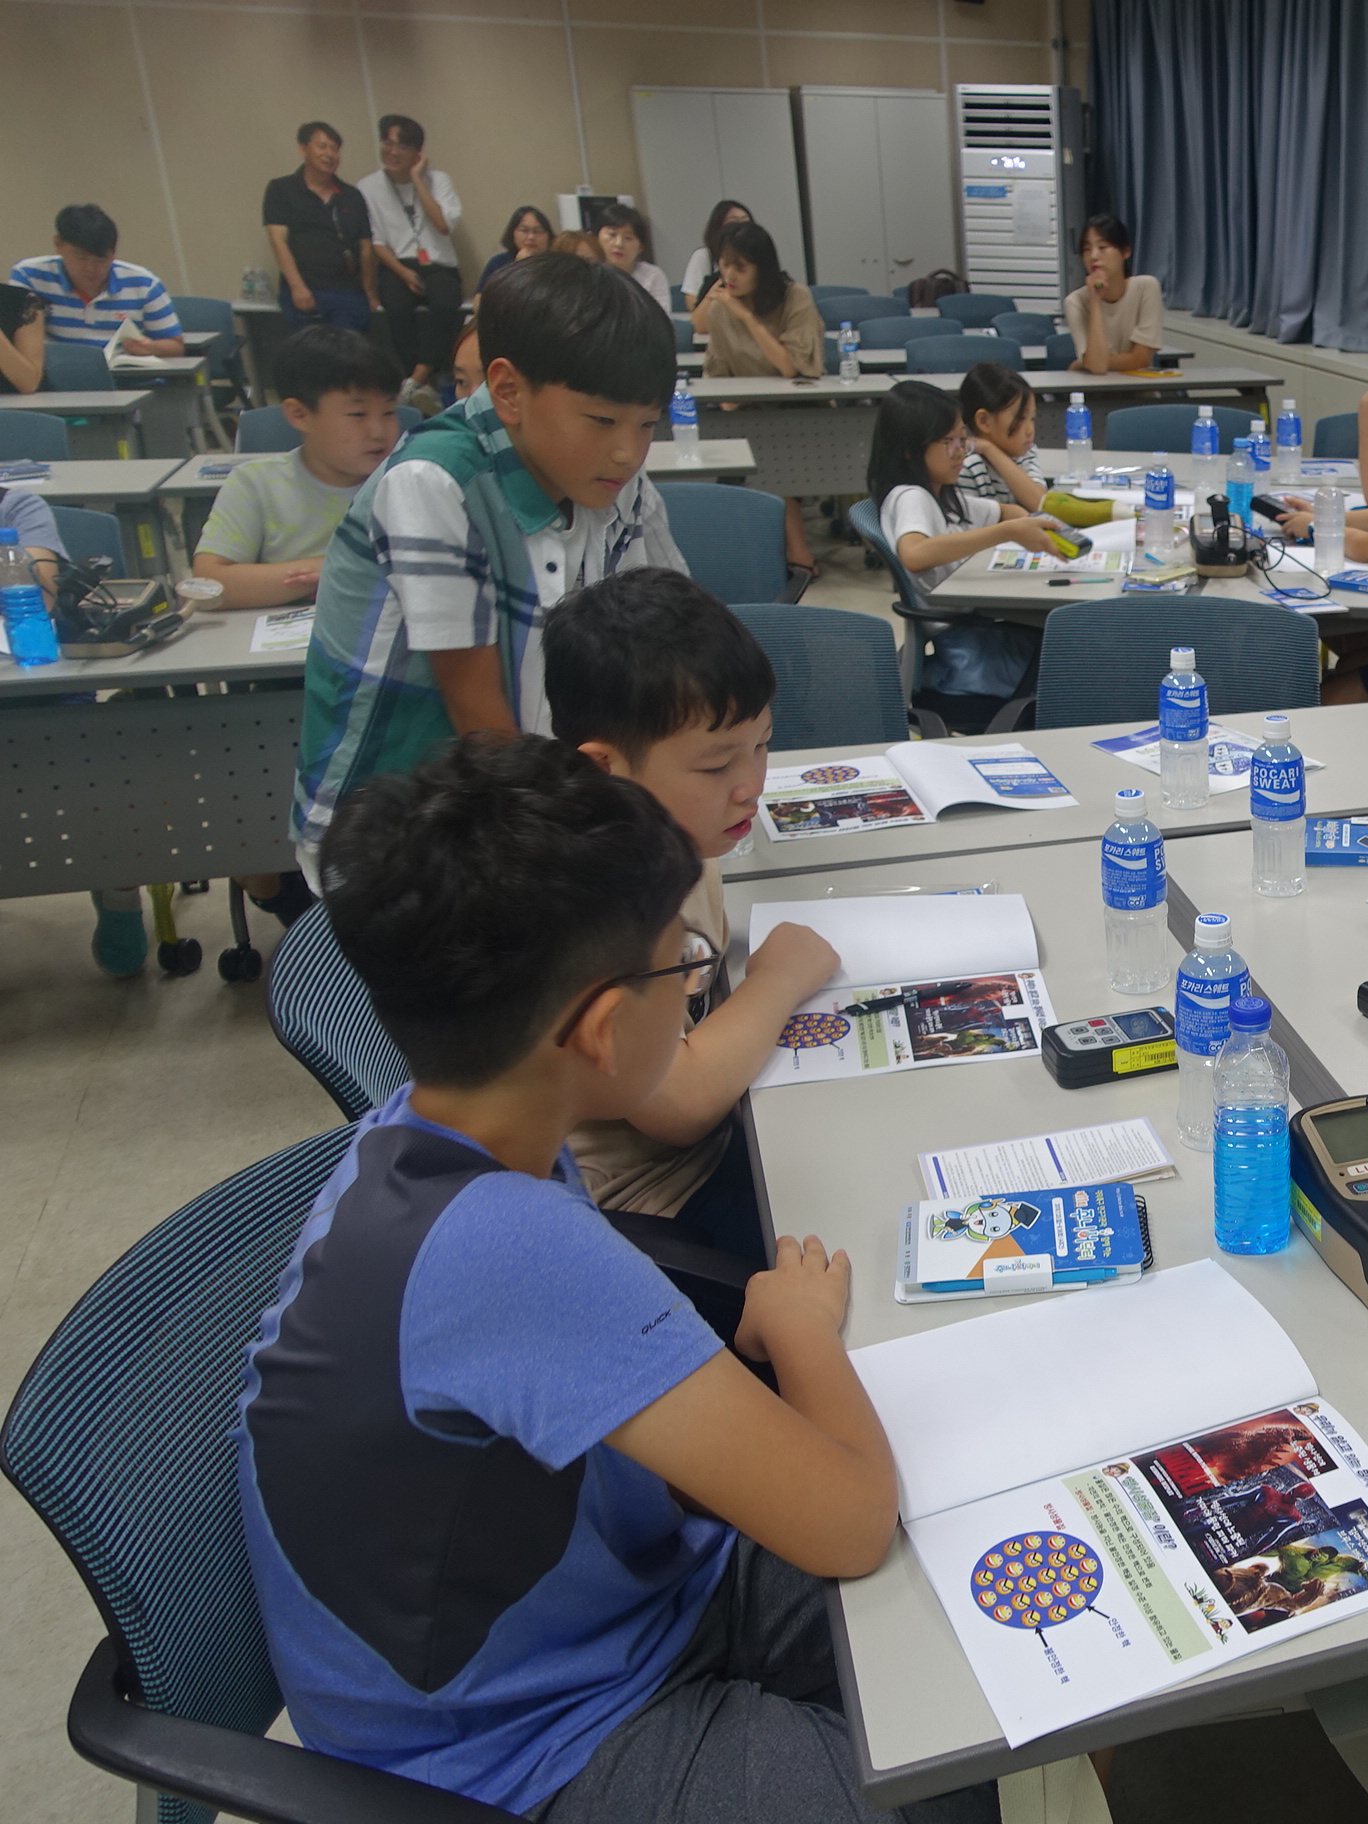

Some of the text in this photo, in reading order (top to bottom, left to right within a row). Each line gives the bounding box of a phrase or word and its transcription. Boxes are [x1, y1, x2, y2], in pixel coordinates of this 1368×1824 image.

[1252, 775, 1296, 790] SWEAT
[1253, 765, 1299, 780] POCARI
[1069, 1208, 1096, 1261] 주니어닥터
[1311, 1413, 1337, 1435] 우리가
[1329, 1434, 1353, 1454] 알고
[1343, 1451, 1364, 1469] 있는
[1043, 1503, 1066, 1530] 방사성물질
[1150, 1523, 1179, 1551] 이란?
[1107, 1616, 1127, 1640] 안정한
[1042, 1647, 1067, 1677] 불안정한
